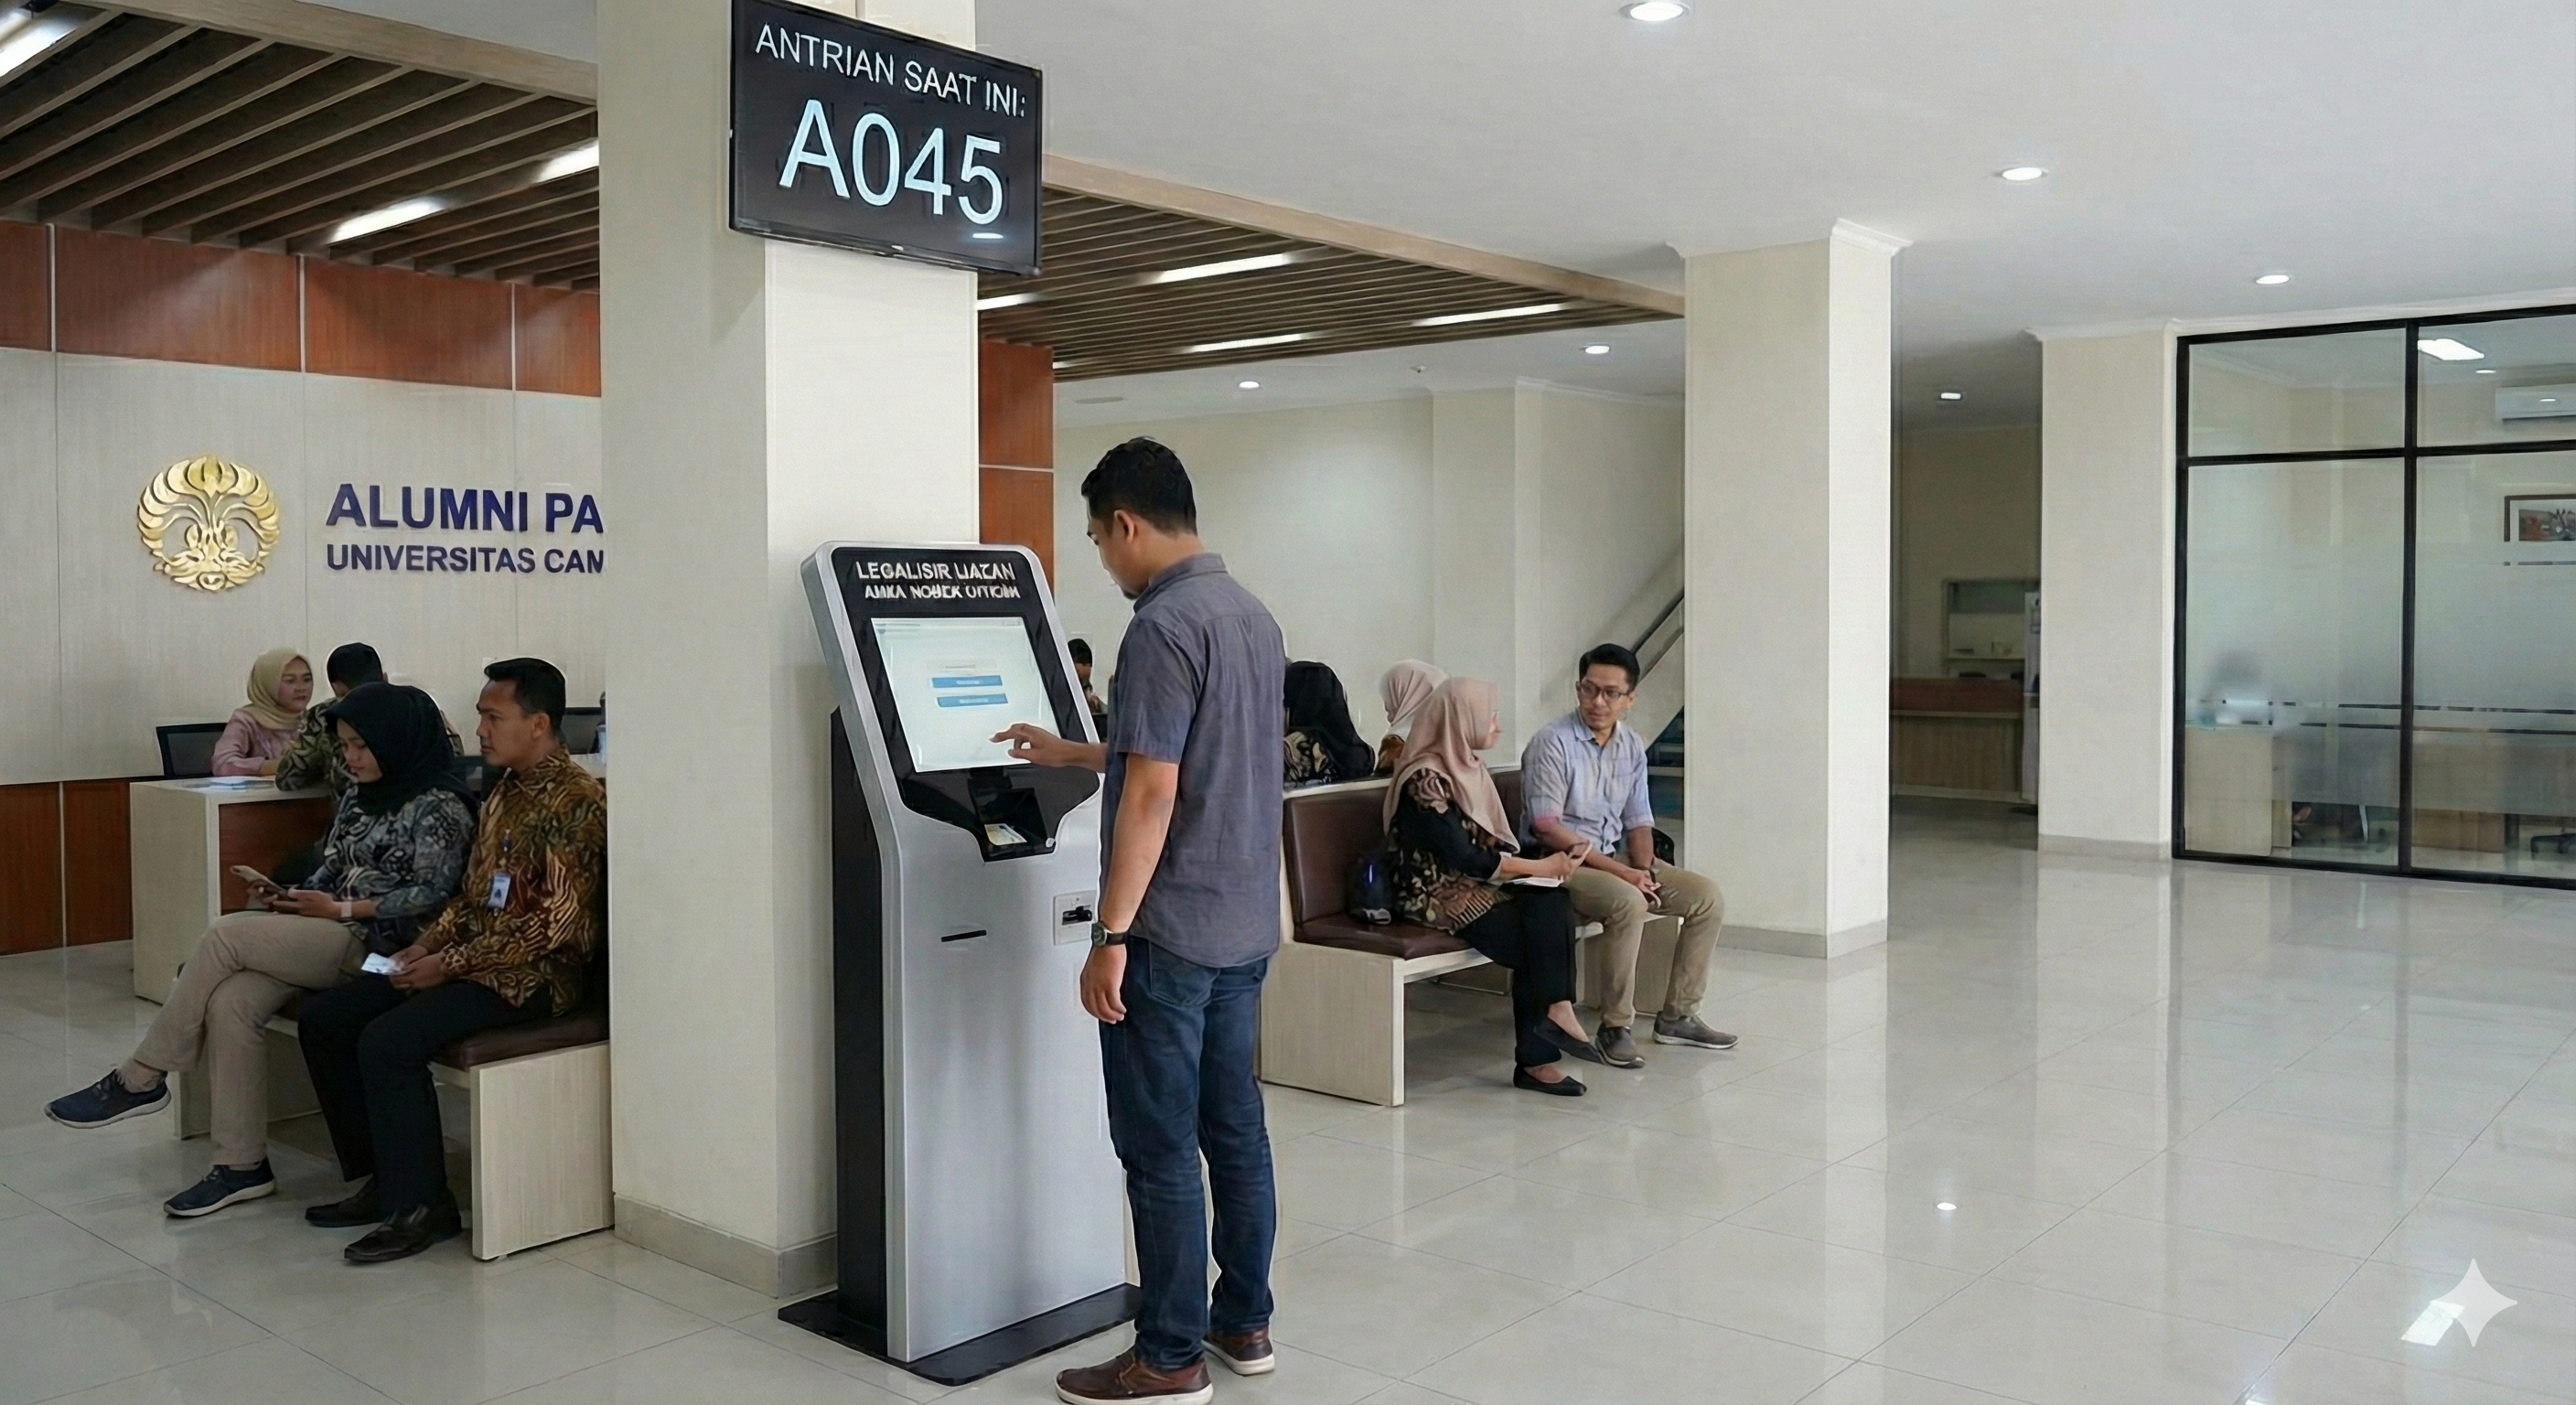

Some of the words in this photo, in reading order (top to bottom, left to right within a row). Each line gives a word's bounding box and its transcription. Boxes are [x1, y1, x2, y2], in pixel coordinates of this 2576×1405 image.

[756, 24, 894, 85] ANTRIAN
[904, 60, 977, 105] SAAT
[985, 80, 1025, 117] INI:
[779, 99, 1003, 225] A045
[326, 483, 528, 532] ALUMNI
[545, 492, 604, 533] PA
[327, 544, 536, 573] UNIVERSITAS
[544, 549, 604, 574] CAN
